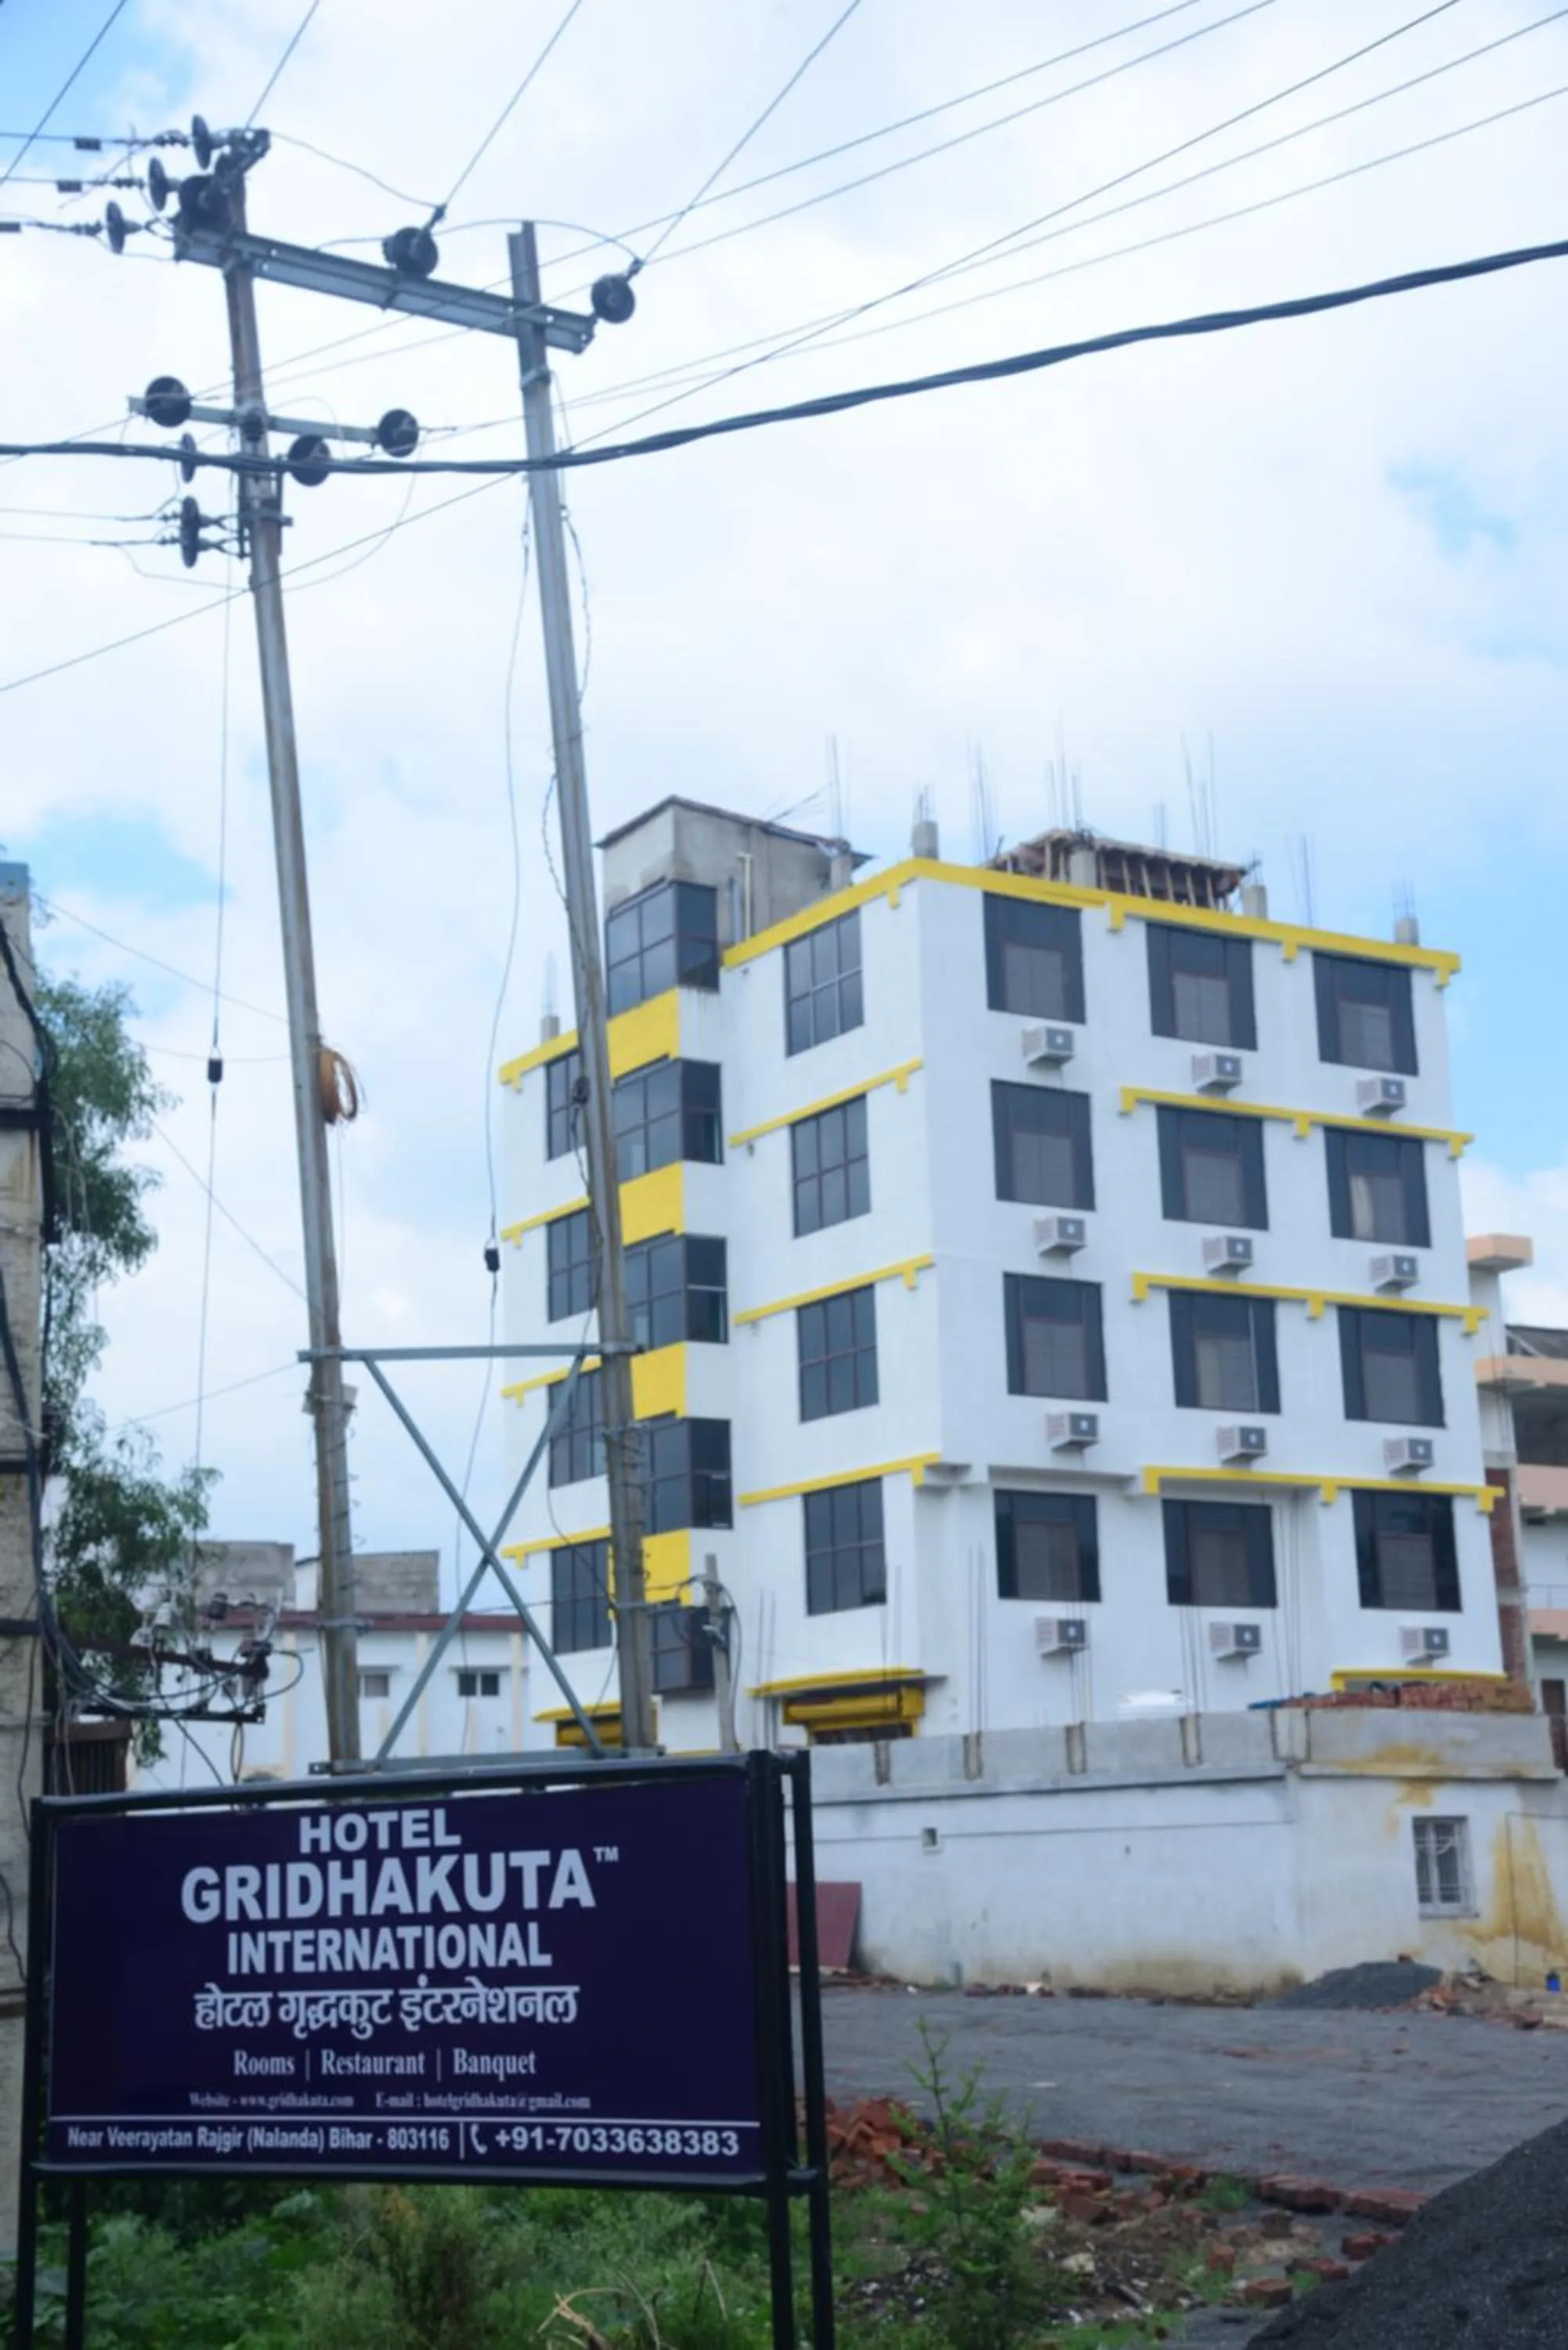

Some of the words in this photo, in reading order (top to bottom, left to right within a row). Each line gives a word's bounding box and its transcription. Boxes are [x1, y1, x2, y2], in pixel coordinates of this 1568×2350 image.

[299, 1808, 461, 1854] HOTEL
[182, 1849, 596, 1923] GRIDHAKUTA
[228, 1922, 552, 1975] INTERNATIONAL
[193, 1982, 273, 2030] होटल
[398, 1973, 580, 2032] इंटरनेशनल
[233, 2049, 295, 2076] Rooms
[321, 2048, 425, 2075] Restaurant
[453, 2048, 537, 2082] Banquet
[67, 2126, 104, 2147] Near
[107, 2125, 193, 2153] Veerayatan
[197, 2126, 244, 2153] Rajgir
[247, 2126, 325, 2153] (Nalanda)
[329, 2126, 374, 2149] Bihar
[387, 2127, 450, 2151] 803116
[495, 2125, 740, 2157] +91-7033638383
